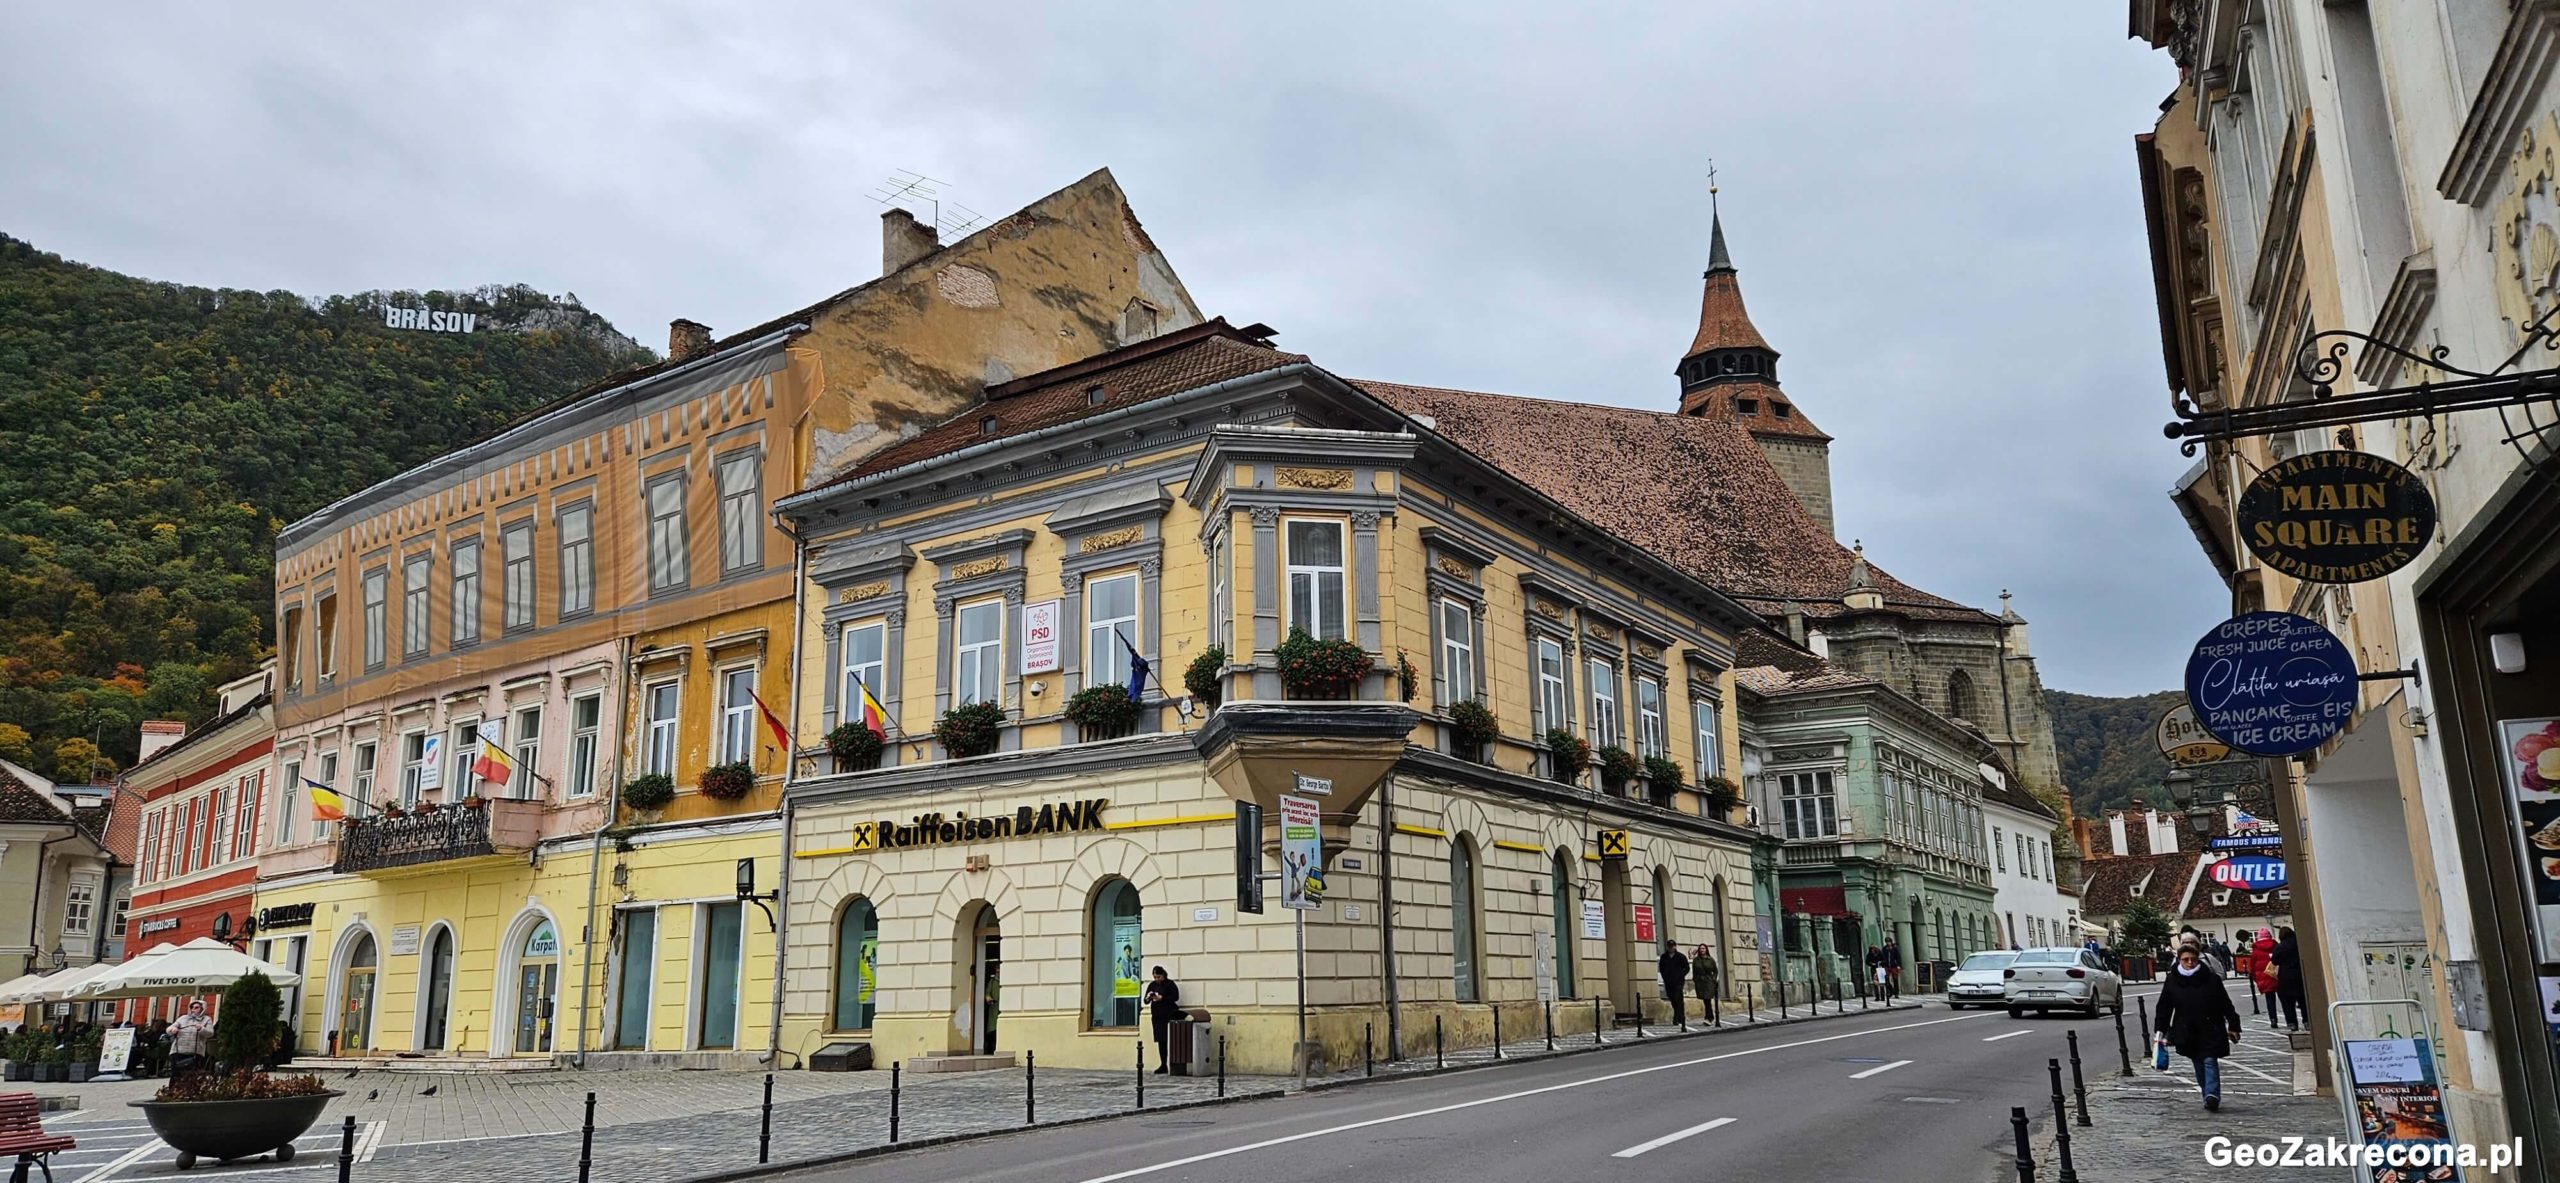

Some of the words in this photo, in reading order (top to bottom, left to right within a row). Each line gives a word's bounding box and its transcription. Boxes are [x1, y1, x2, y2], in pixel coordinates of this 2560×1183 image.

[2256, 453, 2412, 492] APARTMENTS
[2281, 482, 2386, 512] MAIN
[2254, 517, 2420, 549] SQUARE
[2266, 547, 2411, 581] APARTMENTS
[1031, 627, 1049, 640] PSD
[2200, 642, 2243, 659] FRESH
[2248, 637, 2286, 653] JUICE
[2290, 638, 2332, 652] CAFEA
[2210, 704, 2291, 725] PANCAKE
[2285, 713, 2318, 723] COFFEE
[2323, 701, 2352, 718] EIS
[2233, 728, 2264, 746] ICE
[2269, 721, 2336, 743] CREAM
[1283, 798, 1316, 810] Traversarea
[878, 811, 1011, 849] Raiffeisen
[1015, 798, 1109, 836] BANK
[2217, 839, 2249, 847] FAMOUS
[2216, 863, 2286, 882] OUTLET
